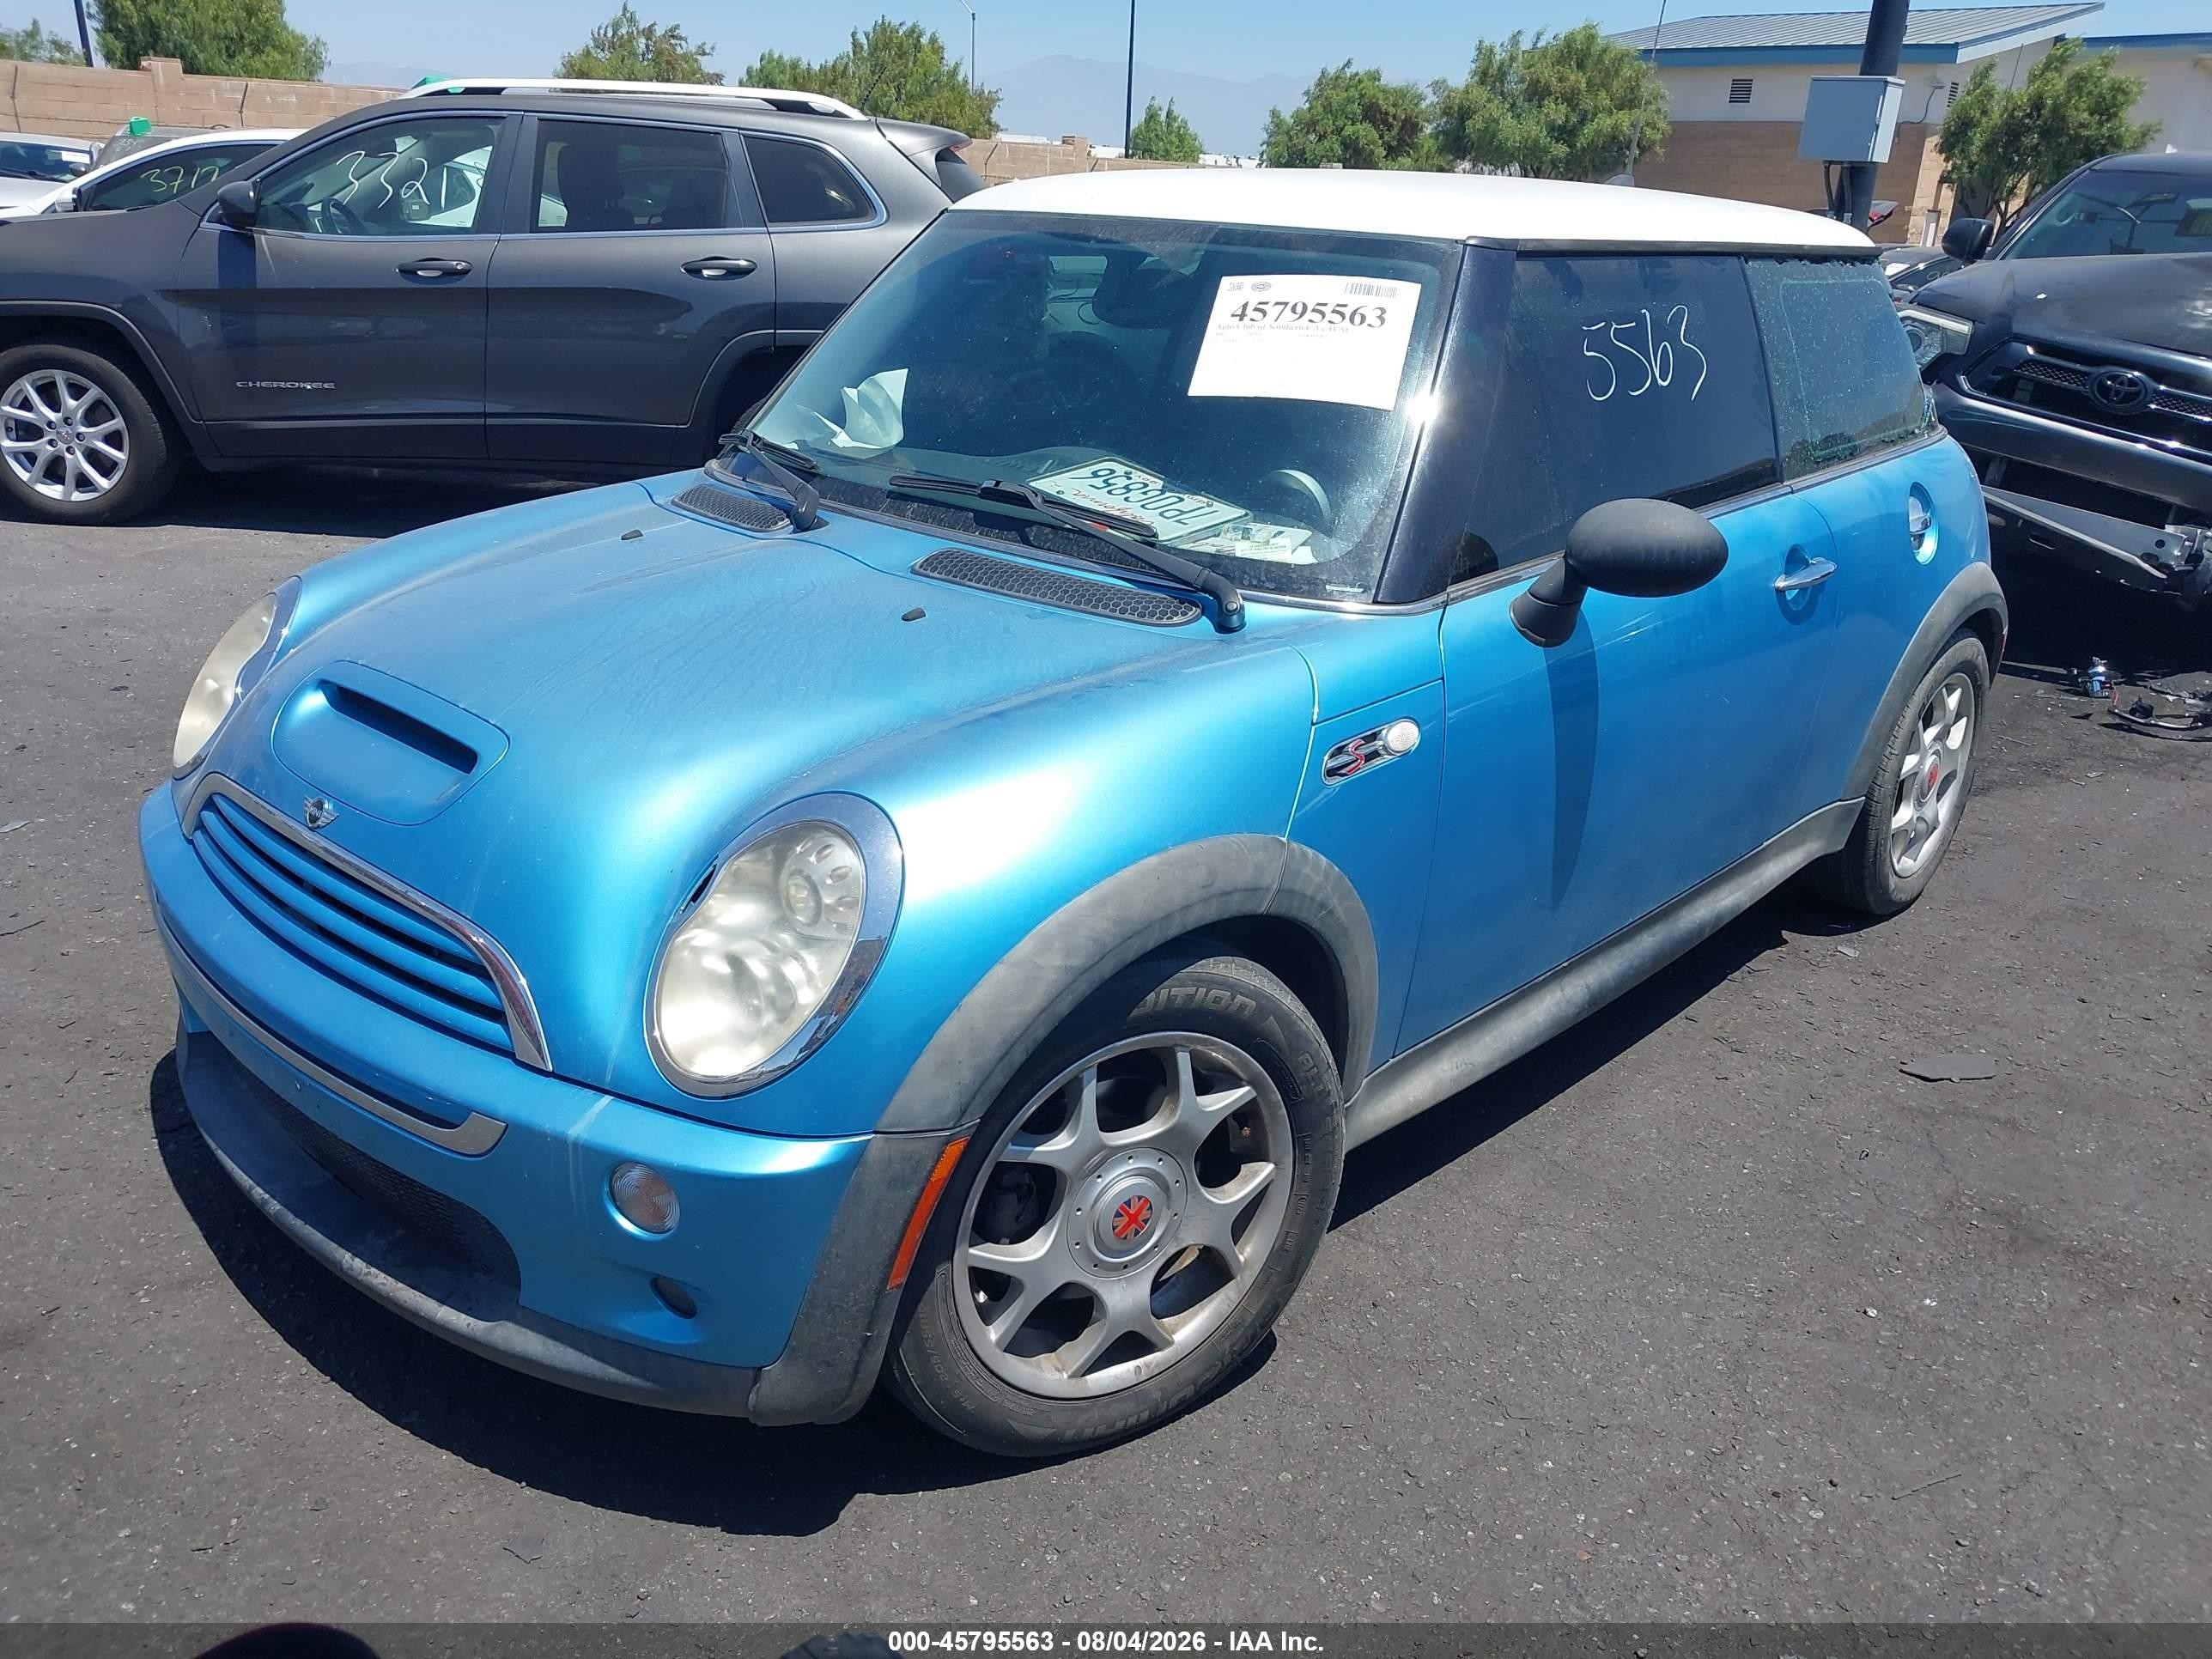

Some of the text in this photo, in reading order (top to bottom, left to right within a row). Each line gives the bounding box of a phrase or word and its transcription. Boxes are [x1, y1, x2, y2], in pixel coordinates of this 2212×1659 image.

[337, 150, 447, 210] 3321
[1230, 301, 1388, 329] 45795563
[1582, 305, 1707, 402] 5563
[235, 381, 337, 390] CHEROKEE
[1346, 738, 1365, 775] S
